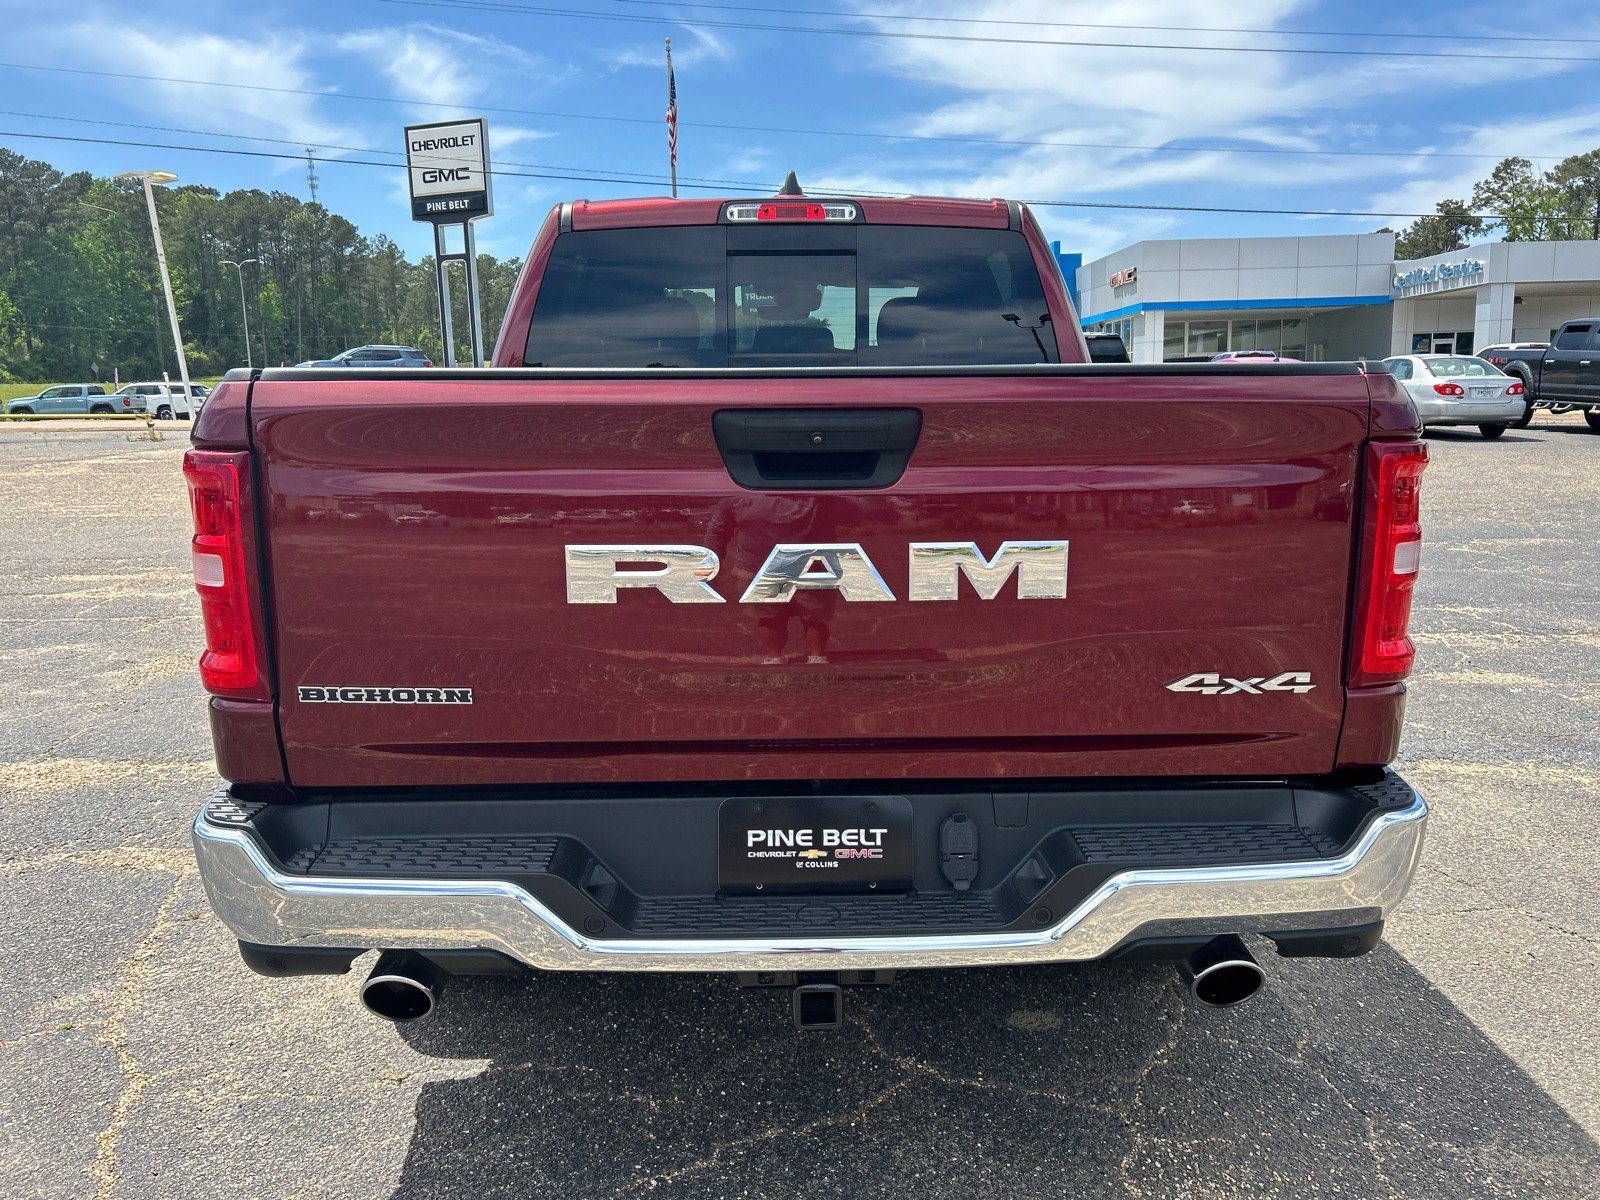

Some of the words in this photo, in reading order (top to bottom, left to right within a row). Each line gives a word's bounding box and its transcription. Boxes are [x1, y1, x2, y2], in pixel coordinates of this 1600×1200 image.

[412, 135, 475, 151] CHEVROLET
[422, 167, 470, 183] GMC
[427, 202, 447, 211] PINE
[449, 200, 469, 209] BELT
[1110, 267, 1137, 288] GMC
[1392, 265, 1436, 289] Certified
[1439, 258, 1483, 281] Service
[565, 540, 1069, 604] RAM
[298, 686, 473, 705] BIGHORN
[747, 829, 813, 847] PINE
[823, 828, 888, 846] BELT
[747, 850, 797, 859] CHEVROLET
[834, 848, 883, 859] GMC
